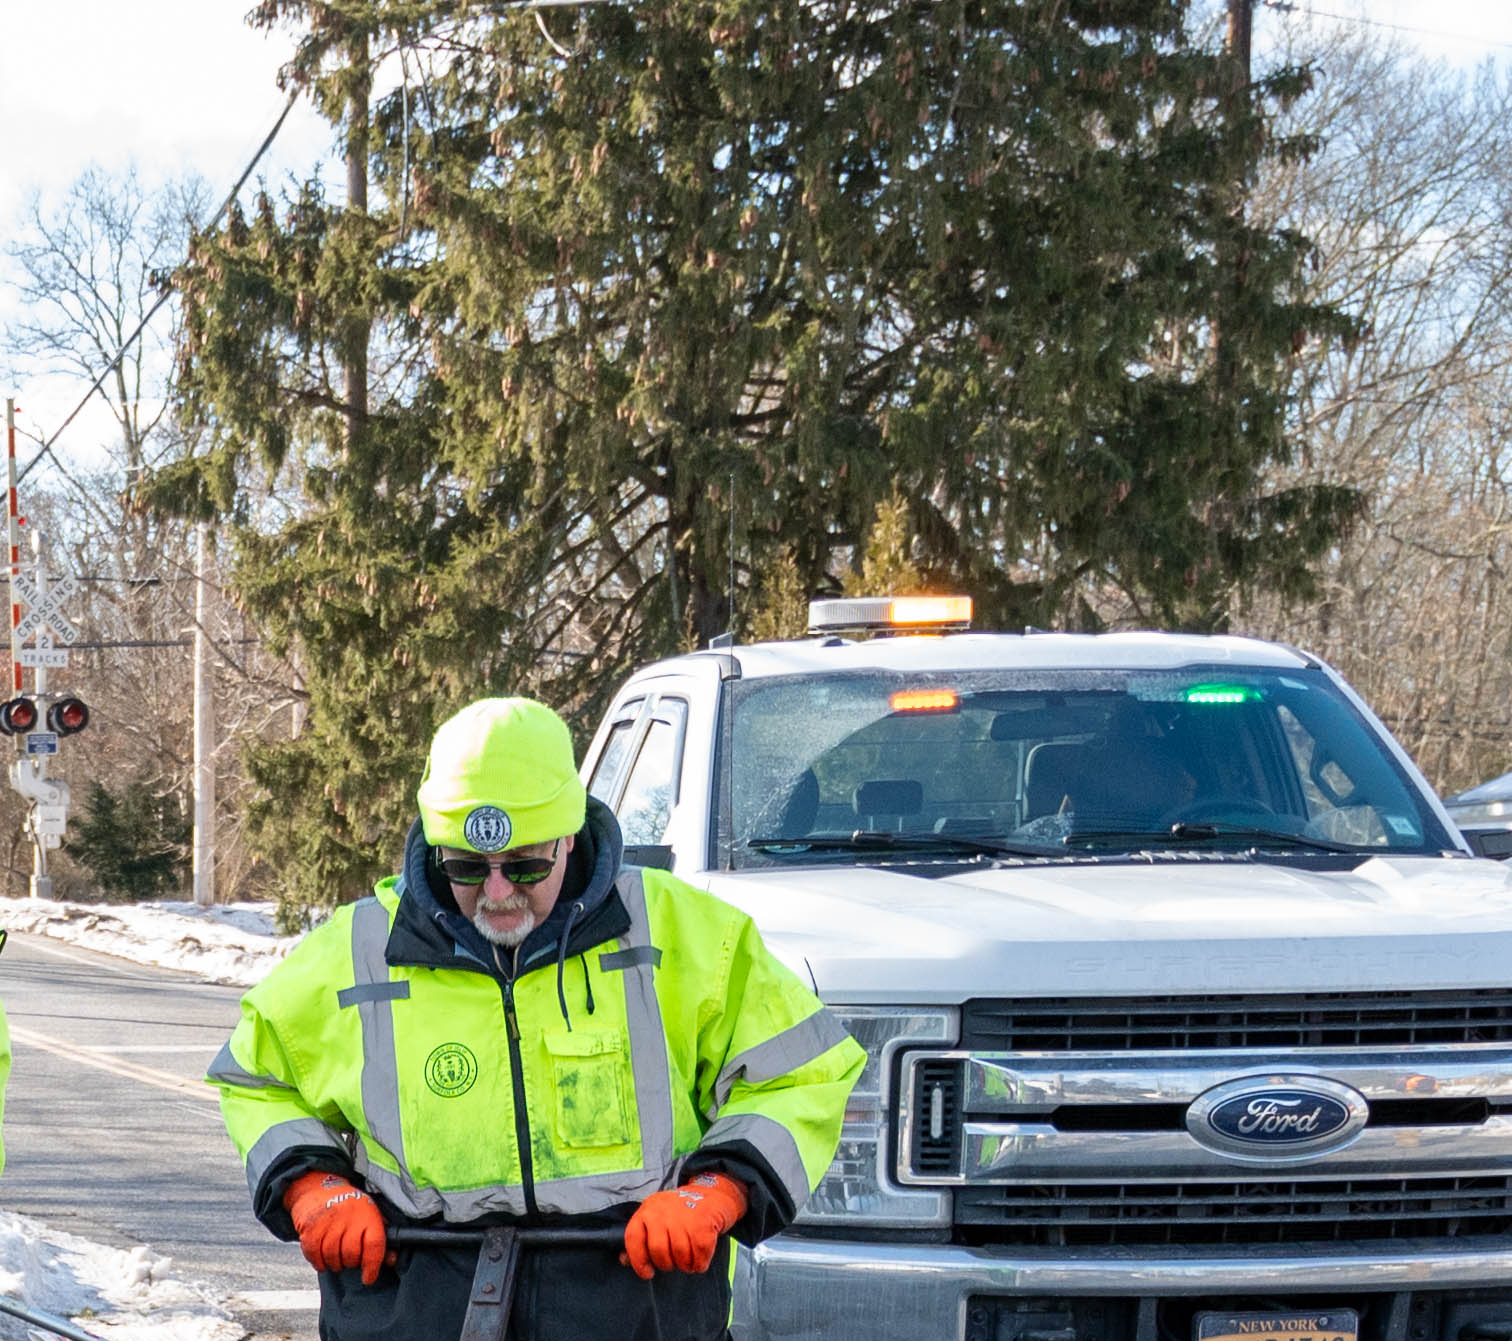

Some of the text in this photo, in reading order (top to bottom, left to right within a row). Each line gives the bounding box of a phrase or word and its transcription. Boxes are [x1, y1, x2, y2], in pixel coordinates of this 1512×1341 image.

[15, 577, 75, 642] RAIL ROAD
[17, 580, 73, 638] CROSSING
[41, 635, 48, 649] 2
[24, 654, 66, 664] TRACKS
[1238, 1098, 1321, 1133] Ford
[1239, 1319, 1318, 1332] NEW YORK
